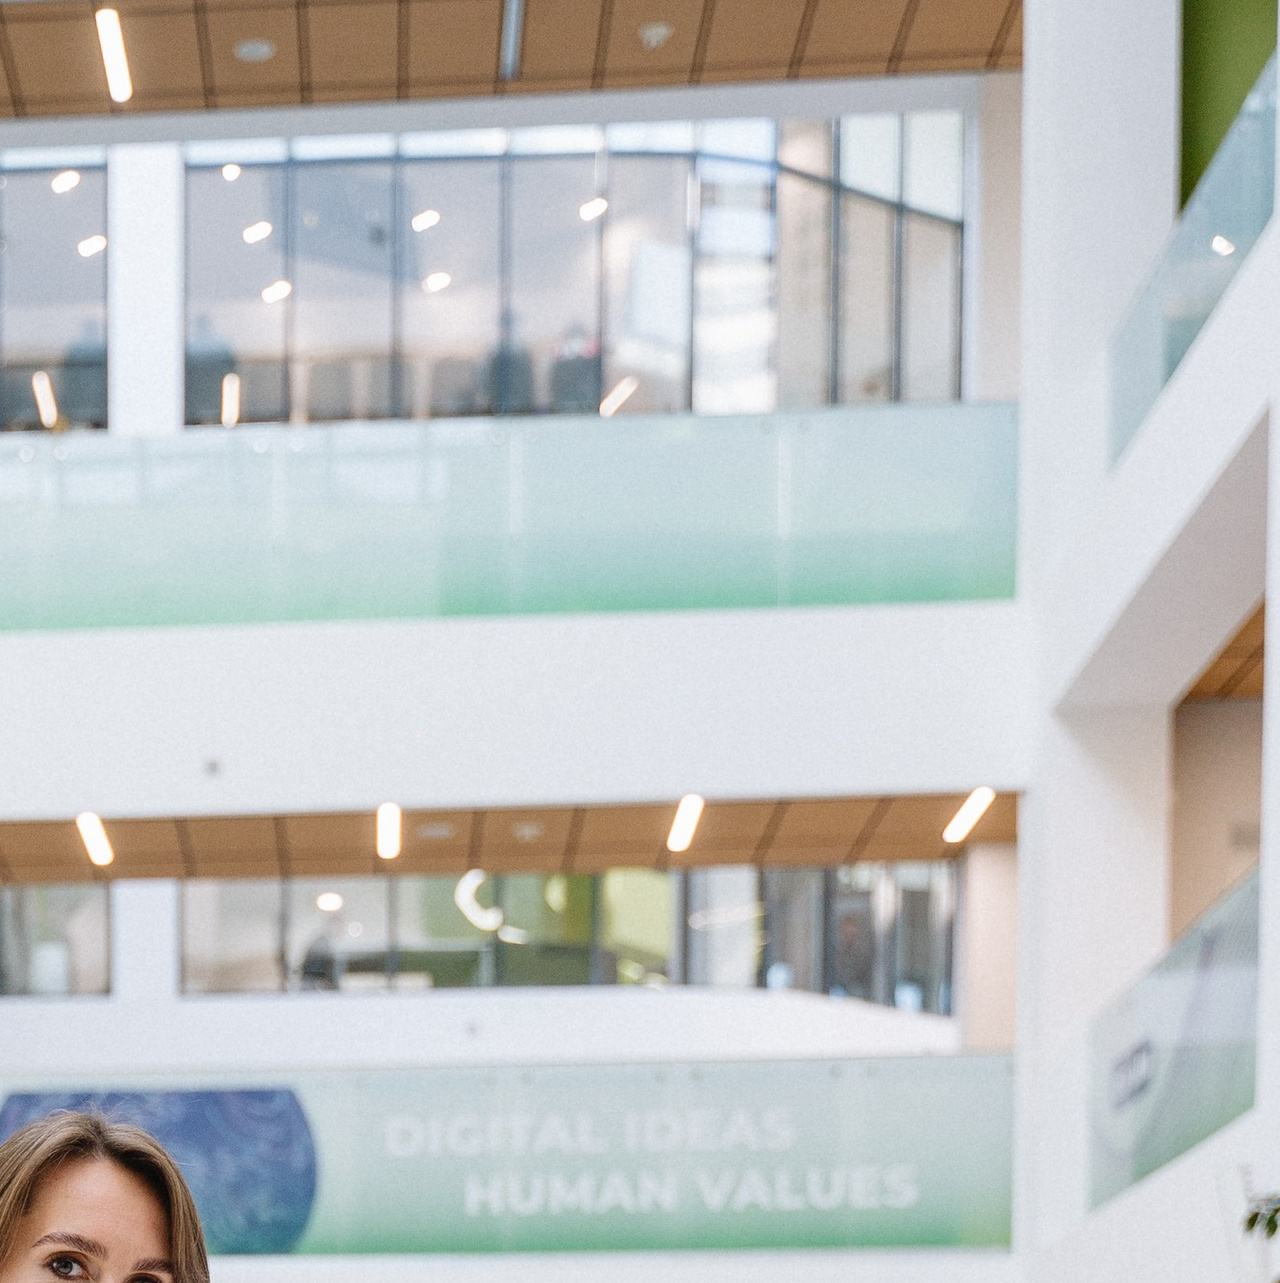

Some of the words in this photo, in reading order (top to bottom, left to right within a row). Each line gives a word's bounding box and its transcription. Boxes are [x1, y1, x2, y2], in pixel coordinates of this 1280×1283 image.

[384, 1110, 608, 1158] DIGITAL
[623, 1106, 796, 1153] IDEAS
[463, 1169, 679, 1217] HUMAN
[697, 1162, 921, 1212] VALUES
